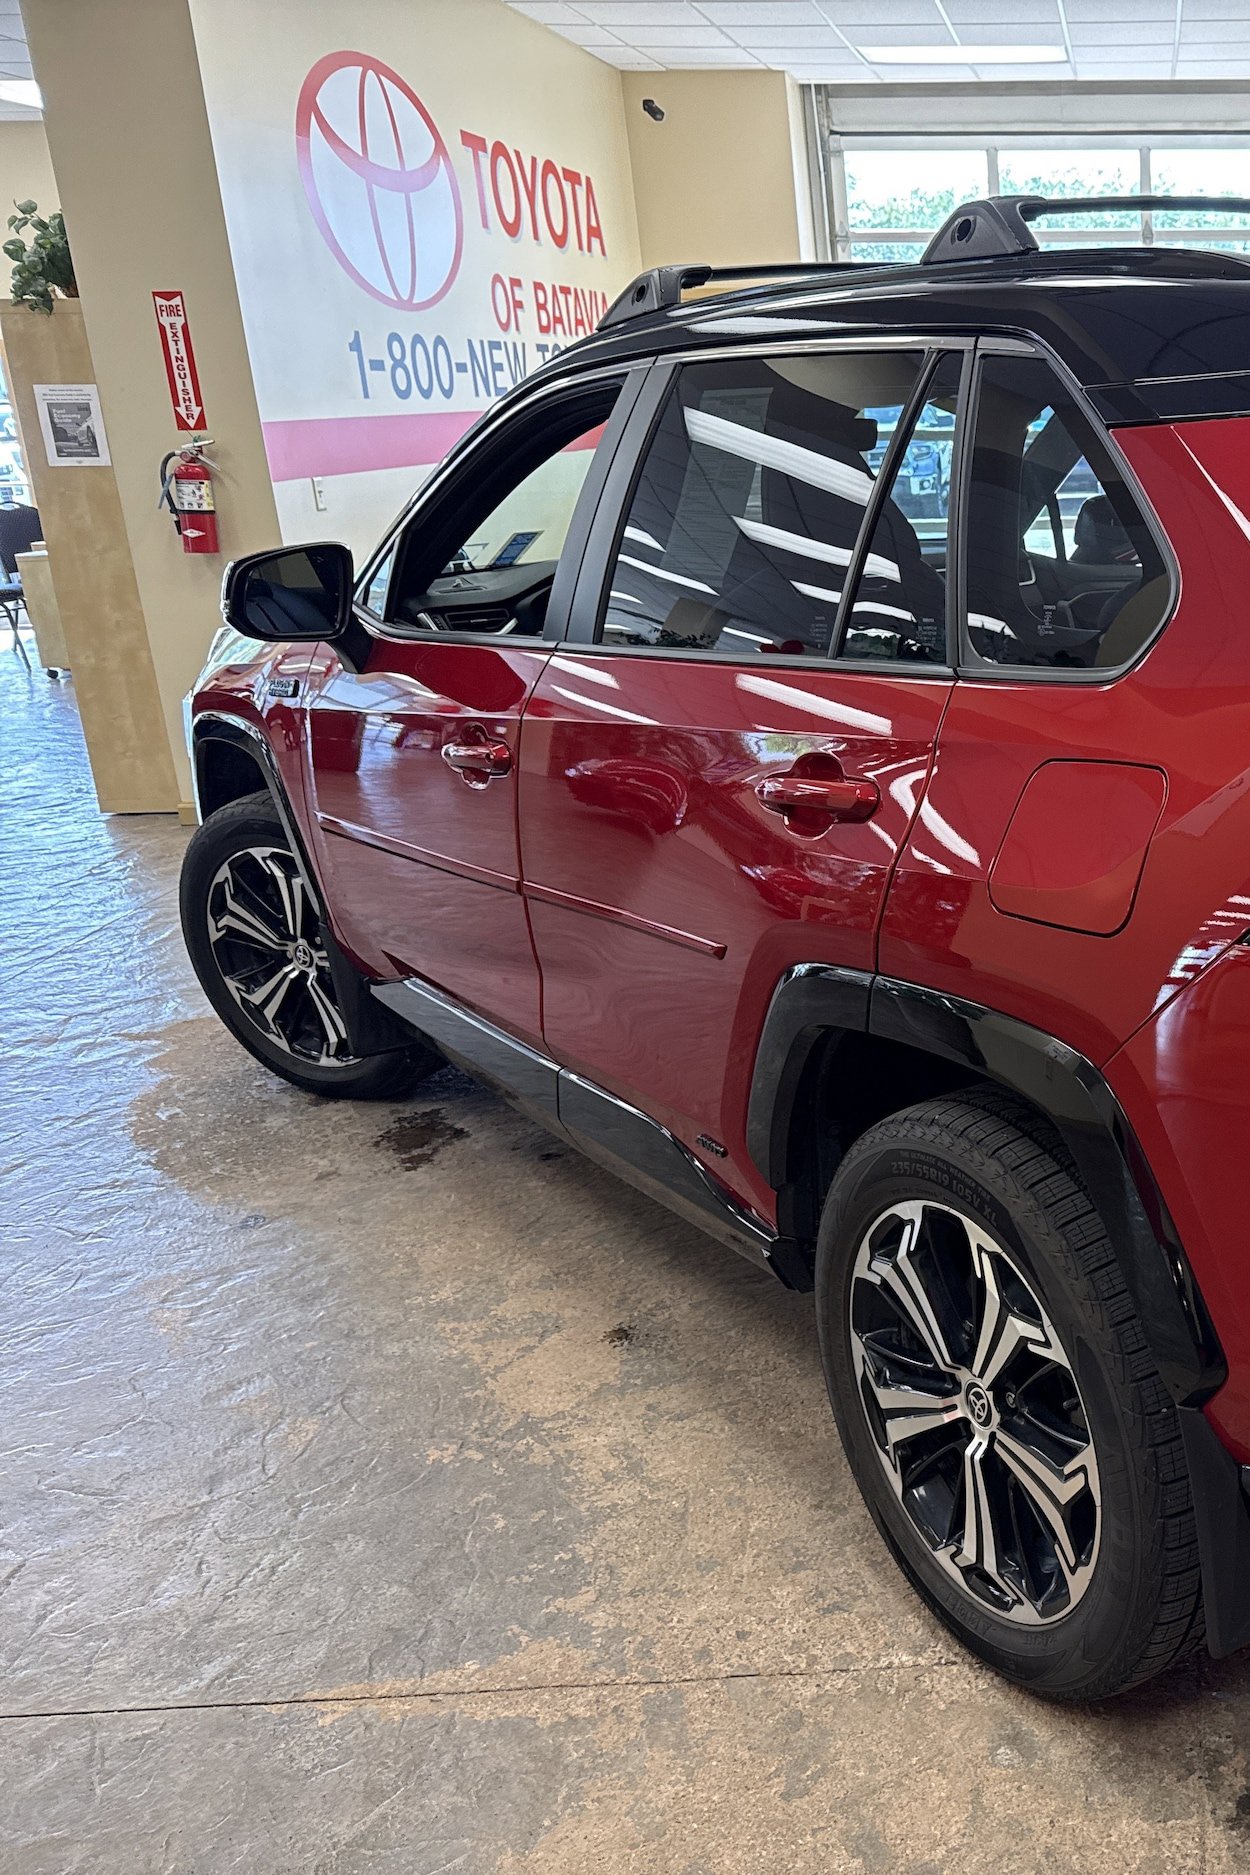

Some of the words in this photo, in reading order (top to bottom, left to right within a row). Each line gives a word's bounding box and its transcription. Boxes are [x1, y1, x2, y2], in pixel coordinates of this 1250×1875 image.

[460, 129, 607, 257] TOYOTA
[159, 304, 182, 317] FIRE
[491, 273, 524, 333] OF
[169, 322, 195, 420] EXTINGUISHER
[349, 330, 527, 400] 1-800-NEW
[891, 1161, 950, 1186] 235/55R19
[952, 1180, 981, 1208] 105V
[983, 1204, 997, 1227] XL
